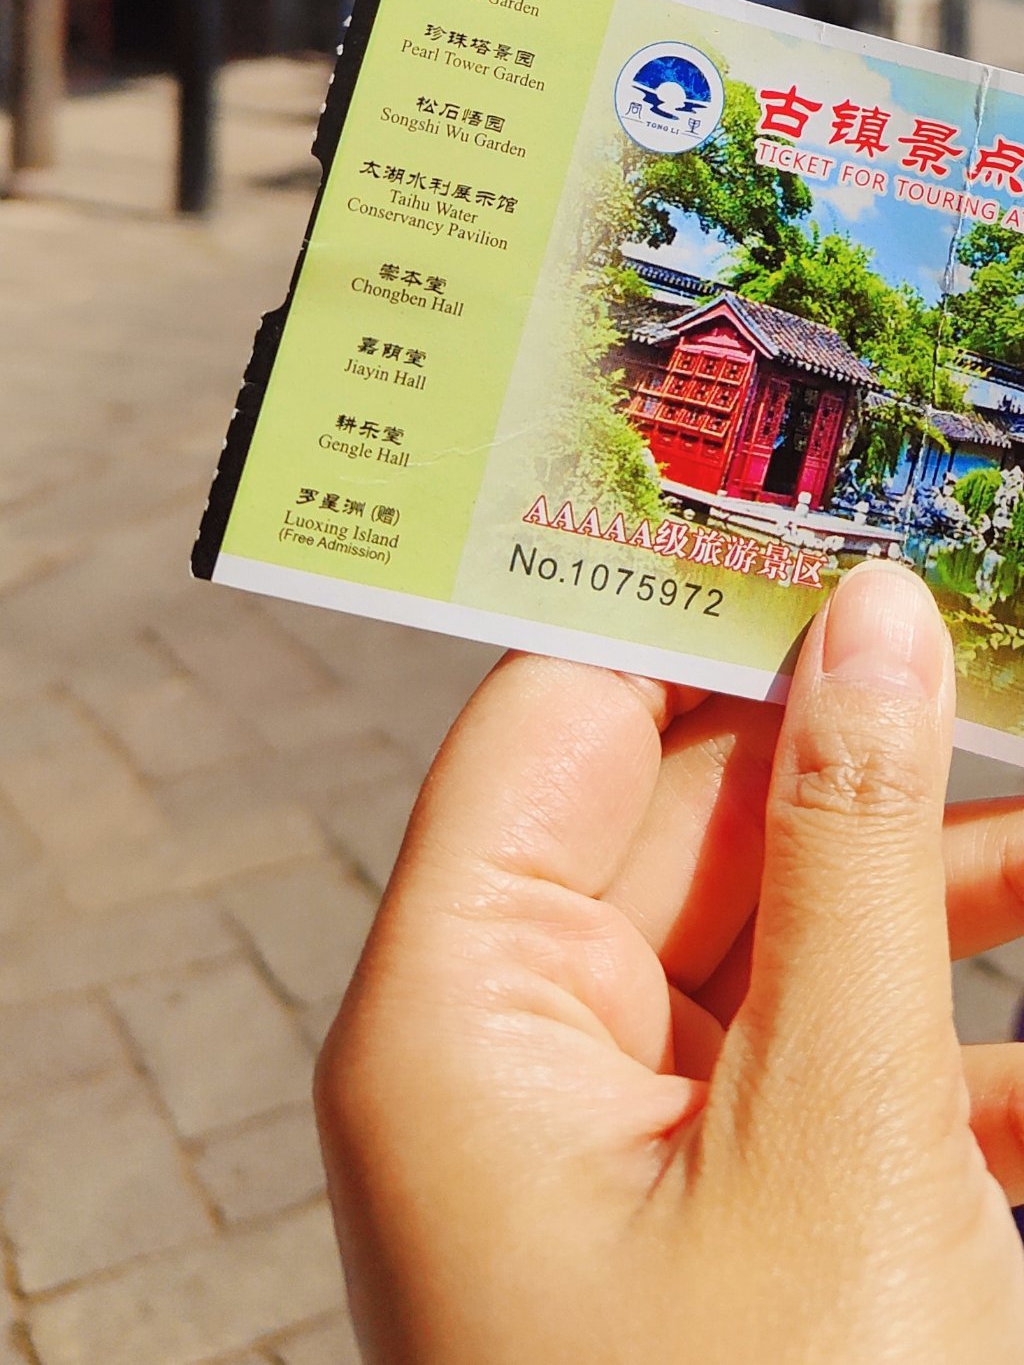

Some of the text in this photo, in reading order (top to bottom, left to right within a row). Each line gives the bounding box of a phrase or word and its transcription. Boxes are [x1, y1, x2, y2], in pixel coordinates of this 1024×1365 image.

[400, 39, 545, 91] Pearl Tower Garden
[424, 24, 536, 68] 珍珠塔景园
[380, 107, 527, 158] Songshi Wu Garden
[416, 96, 506, 133] 松石悟园
[646, 121, 680, 135] TONG LI
[359, 160, 519, 214] 太湖水利展示馆
[758, 142, 834, 177] TICKET
[841, 166, 887, 191] FOR
[897, 179, 996, 220] TOURING
[347, 197, 508, 250] Conservancy Pavilion
[390, 189, 478, 224] Taihu Water
[351, 277, 464, 317] Chongben Hall
[379, 263, 448, 295] 崇本堂
[357, 336, 427, 368] 嘉荫堂
[344, 358, 427, 390] Jiayin Hall
[335, 414, 405, 446] 耕乐堂
[318, 433, 410, 467] Gengle Hall
[279, 527, 391, 565] (Free Admission)
[284, 510, 400, 549] Luoxing Island
[522, 494, 829, 589] AAAAA级旅游景区
[509, 543, 724, 617] No.1075972
